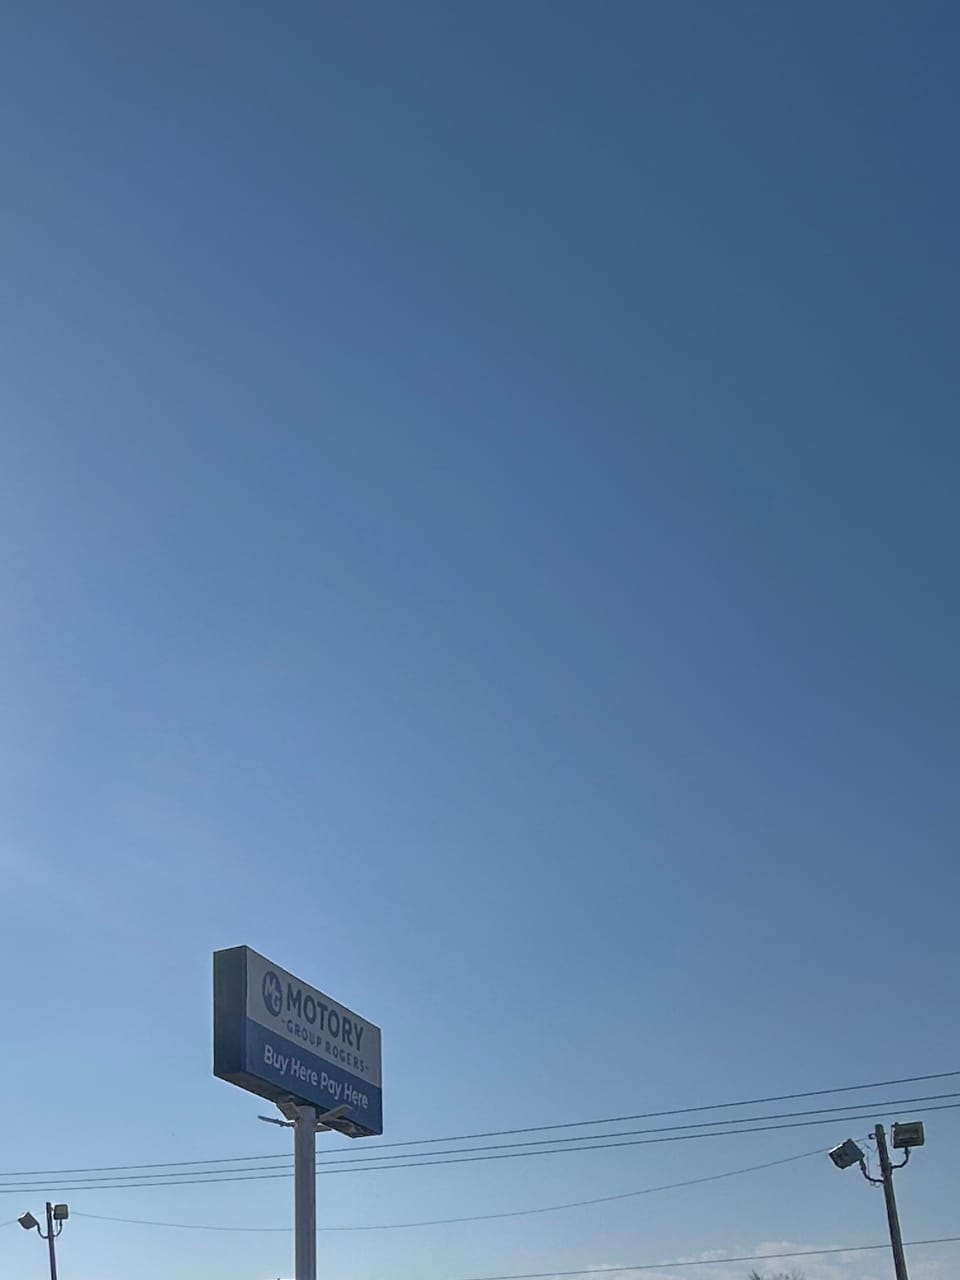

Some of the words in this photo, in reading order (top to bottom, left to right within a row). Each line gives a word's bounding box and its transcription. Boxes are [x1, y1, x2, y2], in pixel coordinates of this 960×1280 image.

[287, 983, 364, 1050] MOTORY
[264, 1045, 289, 1075] Buy
[290, 1058, 318, 1085] Here
[321, 1073, 342, 1100] Pay
[344, 1083, 368, 1108] Here
